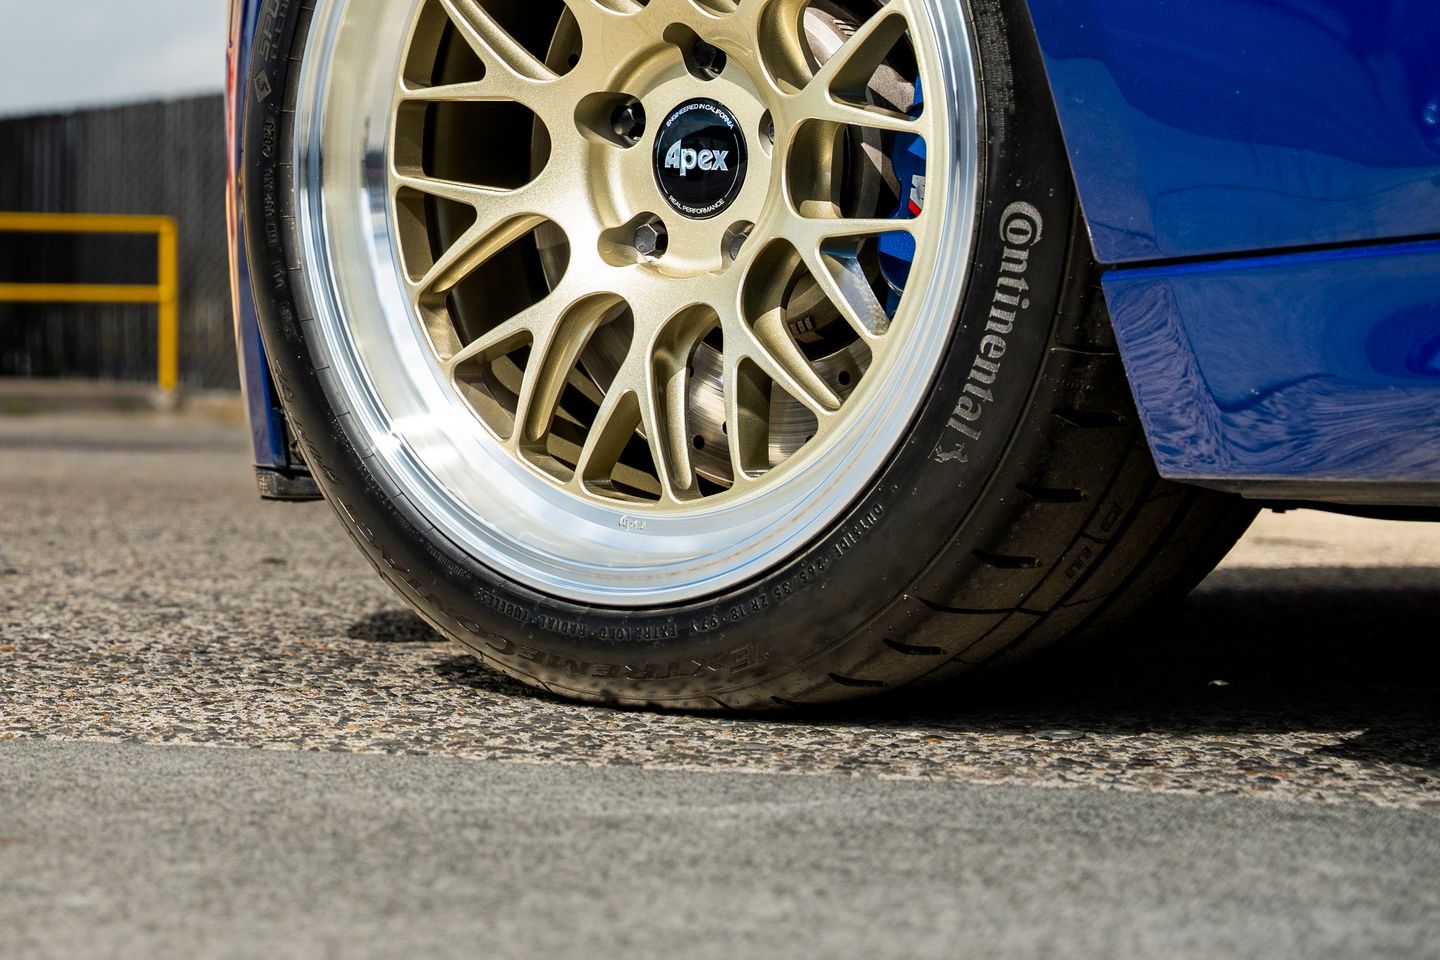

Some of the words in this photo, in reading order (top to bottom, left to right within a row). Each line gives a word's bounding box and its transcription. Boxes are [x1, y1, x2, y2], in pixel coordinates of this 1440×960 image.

[666, 103, 699, 128] ENGINEERED
[705, 104, 734, 130] CALIFORNIA
[664, 139, 729, 177] Apex
[669, 195, 682, 210] REAL
[682, 197, 725, 215] PERFORMANCE
[946, 201, 1044, 441] Continental
